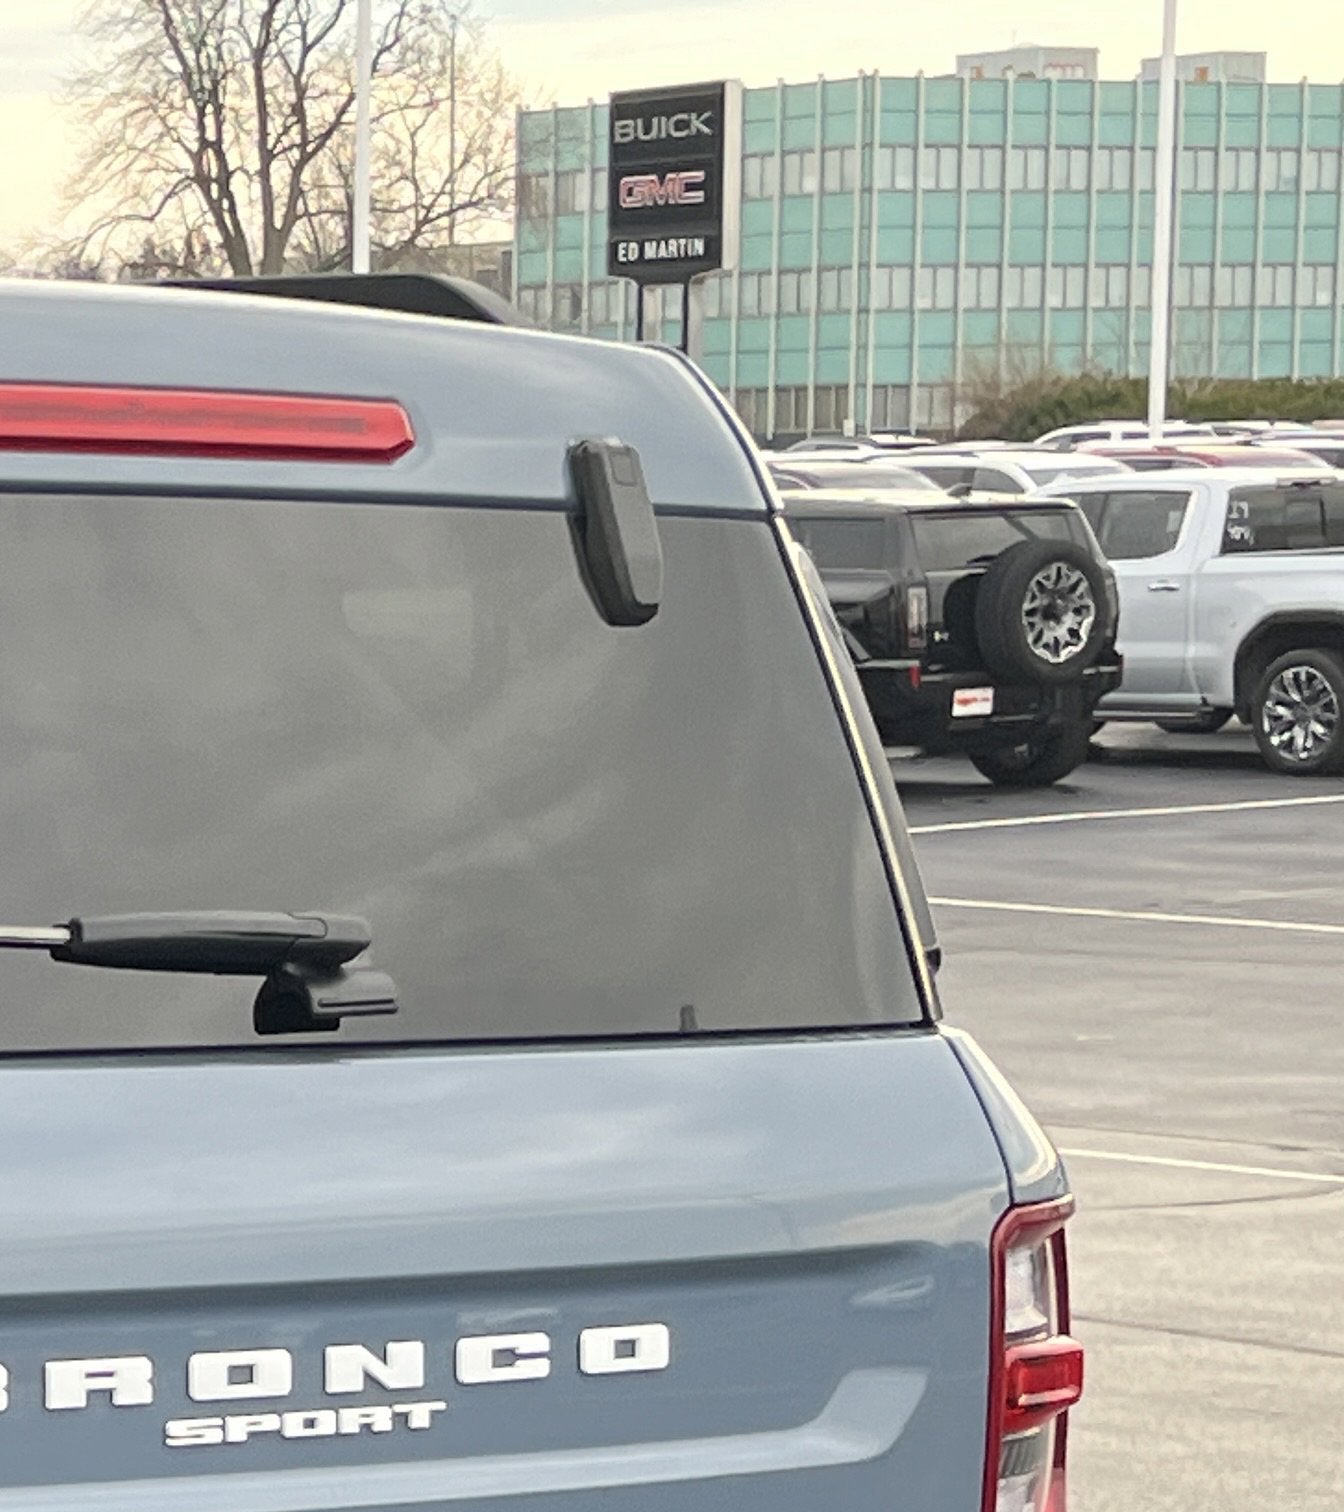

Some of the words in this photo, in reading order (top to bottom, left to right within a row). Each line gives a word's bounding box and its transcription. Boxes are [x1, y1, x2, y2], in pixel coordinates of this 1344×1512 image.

[614, 111, 713, 143] BUICK
[619, 170, 705, 209] GMC
[617, 241, 639, 262] ED
[643, 238, 705, 260] MARTIN
[164, 1401, 447, 1447] SPORT
